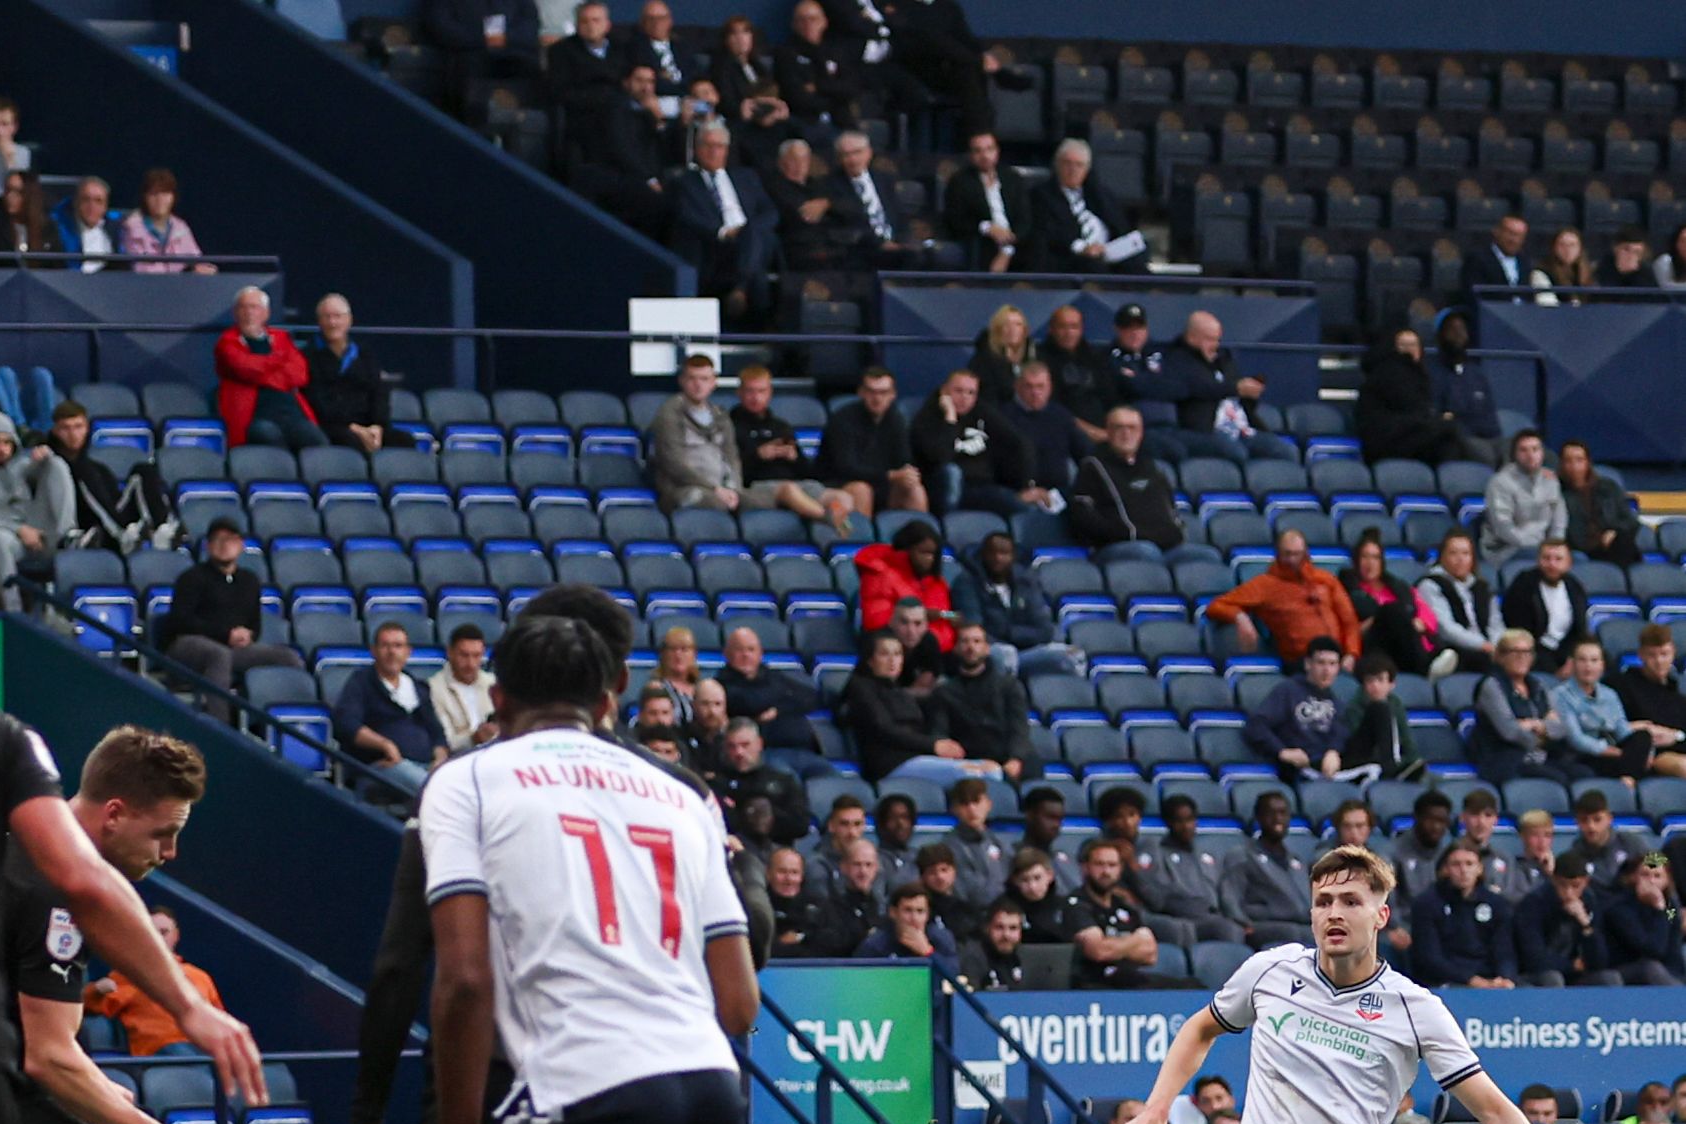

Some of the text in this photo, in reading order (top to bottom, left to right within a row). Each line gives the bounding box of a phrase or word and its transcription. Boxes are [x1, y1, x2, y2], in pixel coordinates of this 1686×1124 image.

[513, 764, 685, 809] NLUNDULU
[786, 1019, 894, 1063] CHW
[998, 1002, 1168, 1065] eventura
[1295, 1030, 1366, 1061] plumbing
[1300, 1016, 1370, 1045] victorian
[1465, 1018, 1580, 1050] Business
